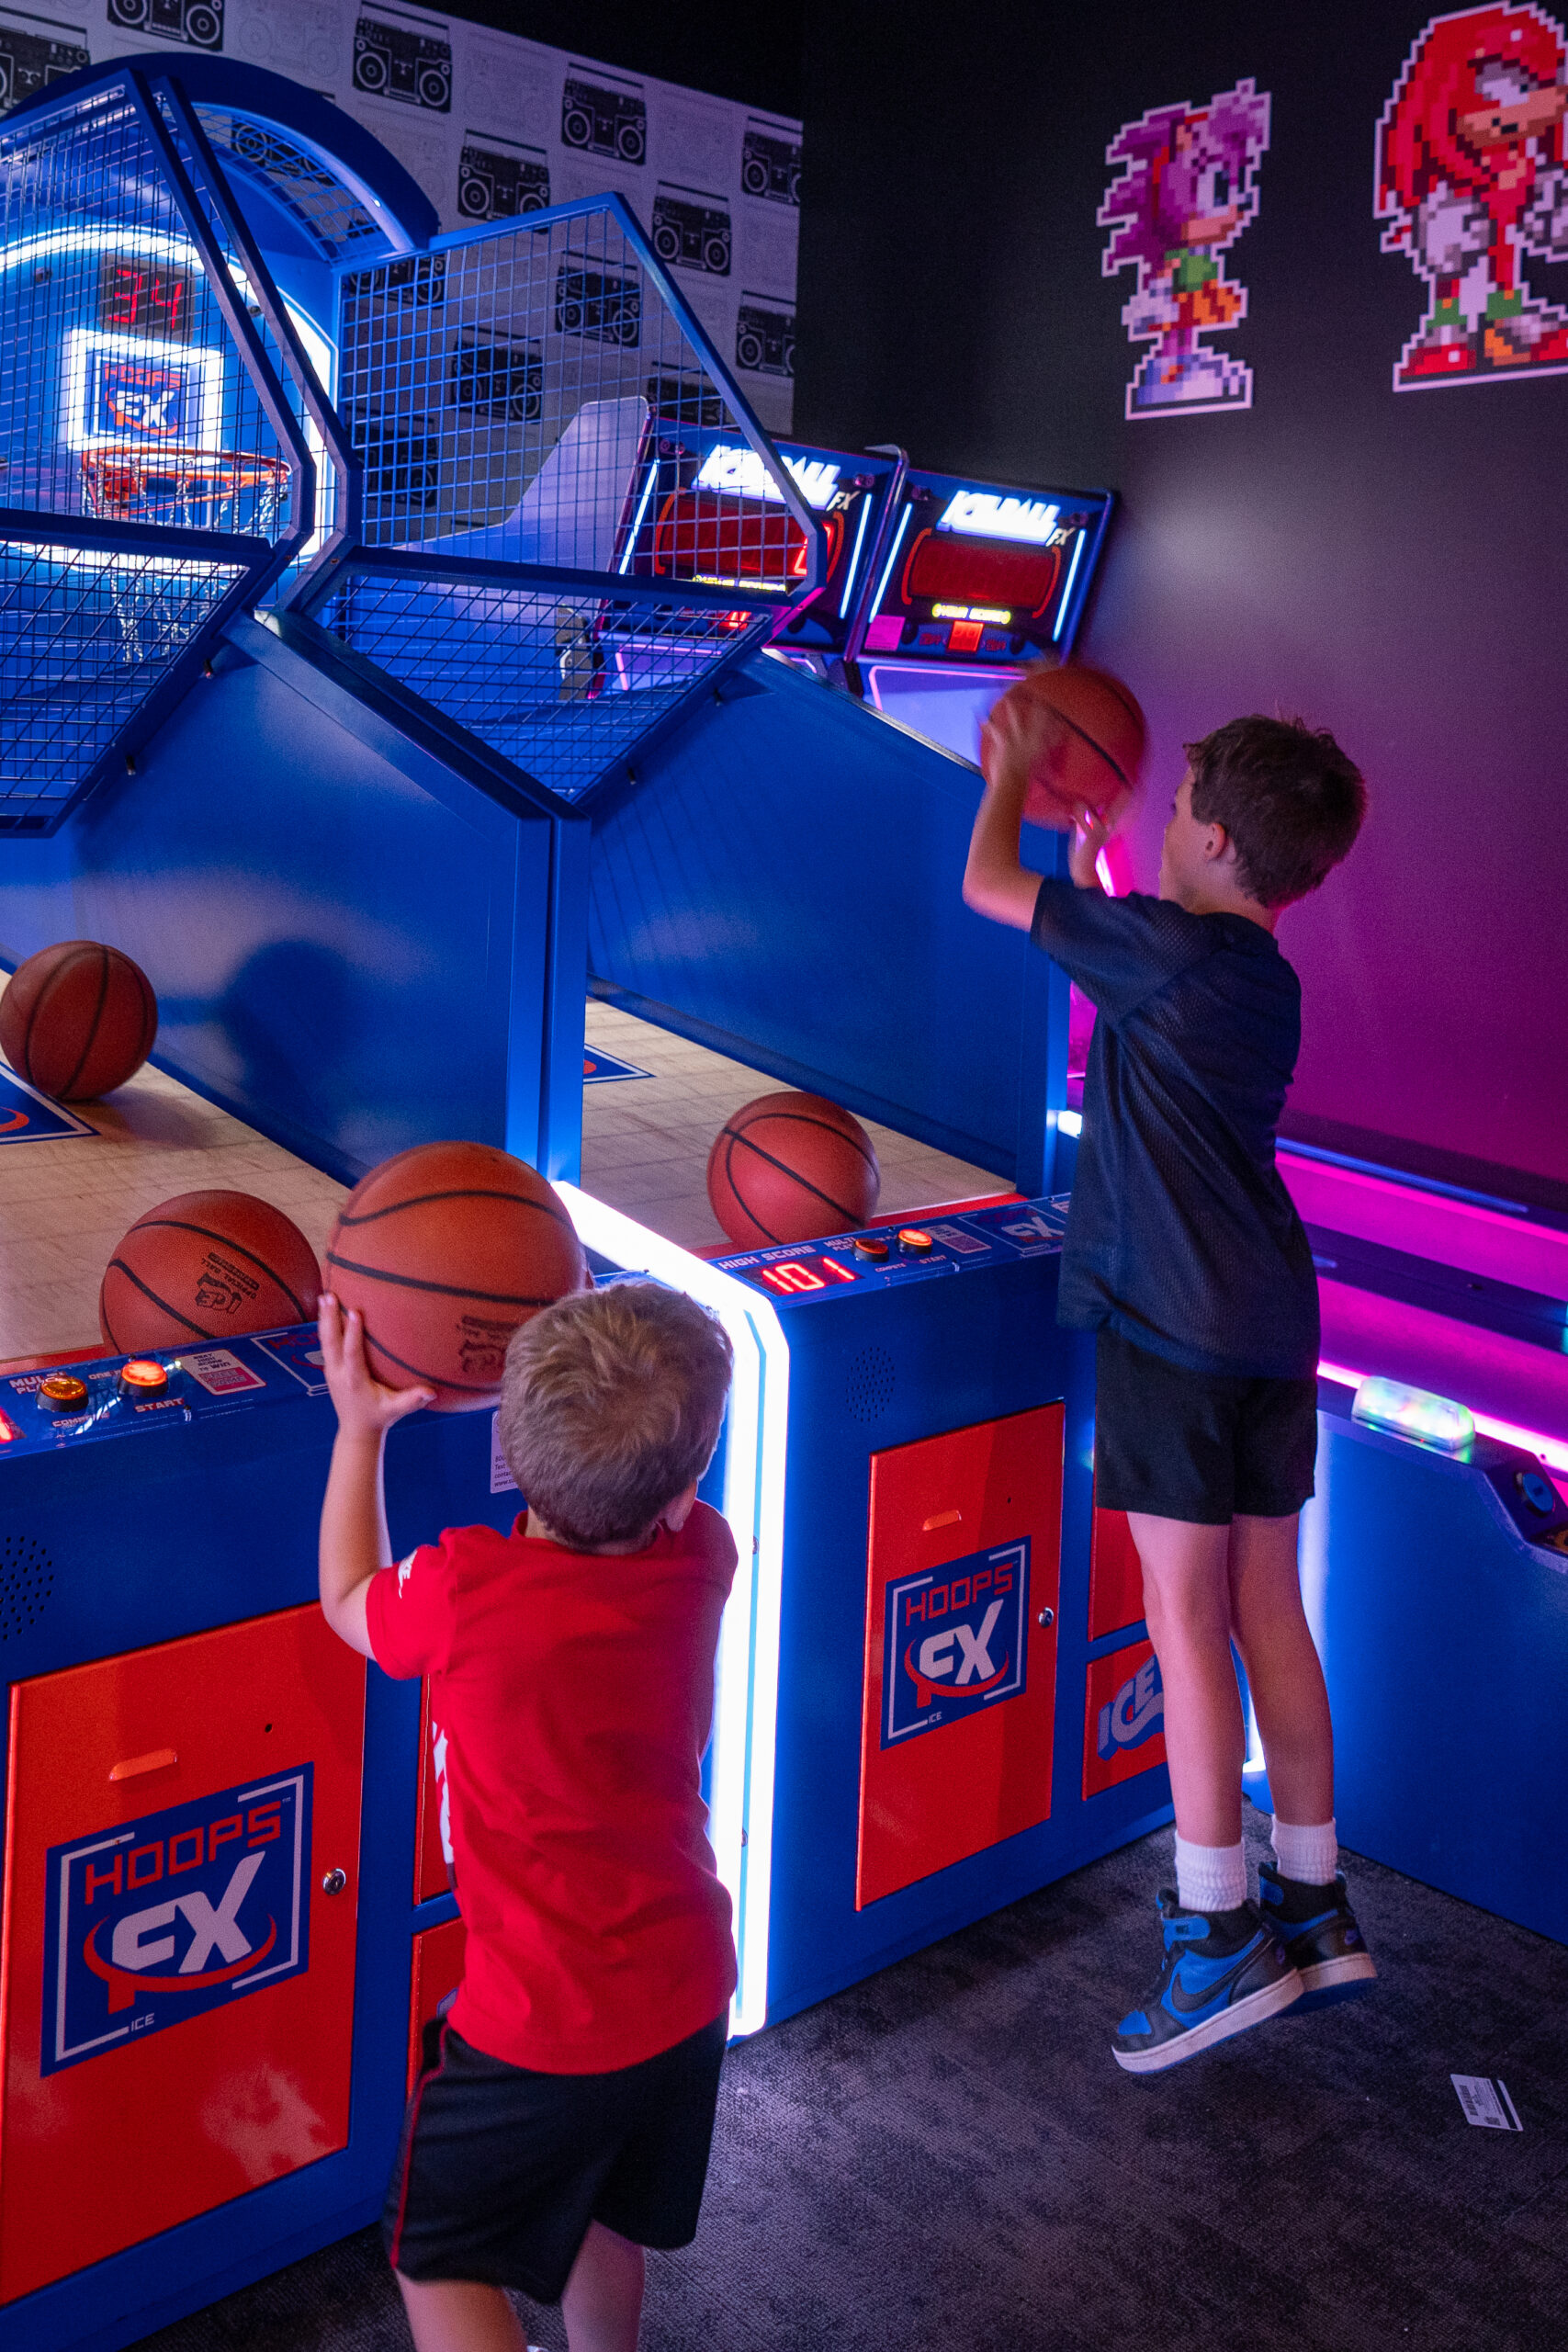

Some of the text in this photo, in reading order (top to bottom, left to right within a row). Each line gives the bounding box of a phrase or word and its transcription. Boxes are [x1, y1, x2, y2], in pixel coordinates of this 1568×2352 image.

[107, 268, 183, 330] 34
[105, 363, 181, 390] HOOPS
[826, 490, 861, 512] FX
[823, 1236, 856, 1248] MULTI
[717, 1244, 817, 1270] HIGH SCORE
[761, 1256, 856, 1294] 101
[134, 1397, 185, 1413] START
[906, 1563, 1013, 1627] HOOPS
[929, 1711, 943, 1724] ICE
[1098, 1654, 1164, 1761] ICE
[85, 1800, 281, 1905] HOOPS
[130, 2011, 155, 2033] ICE
